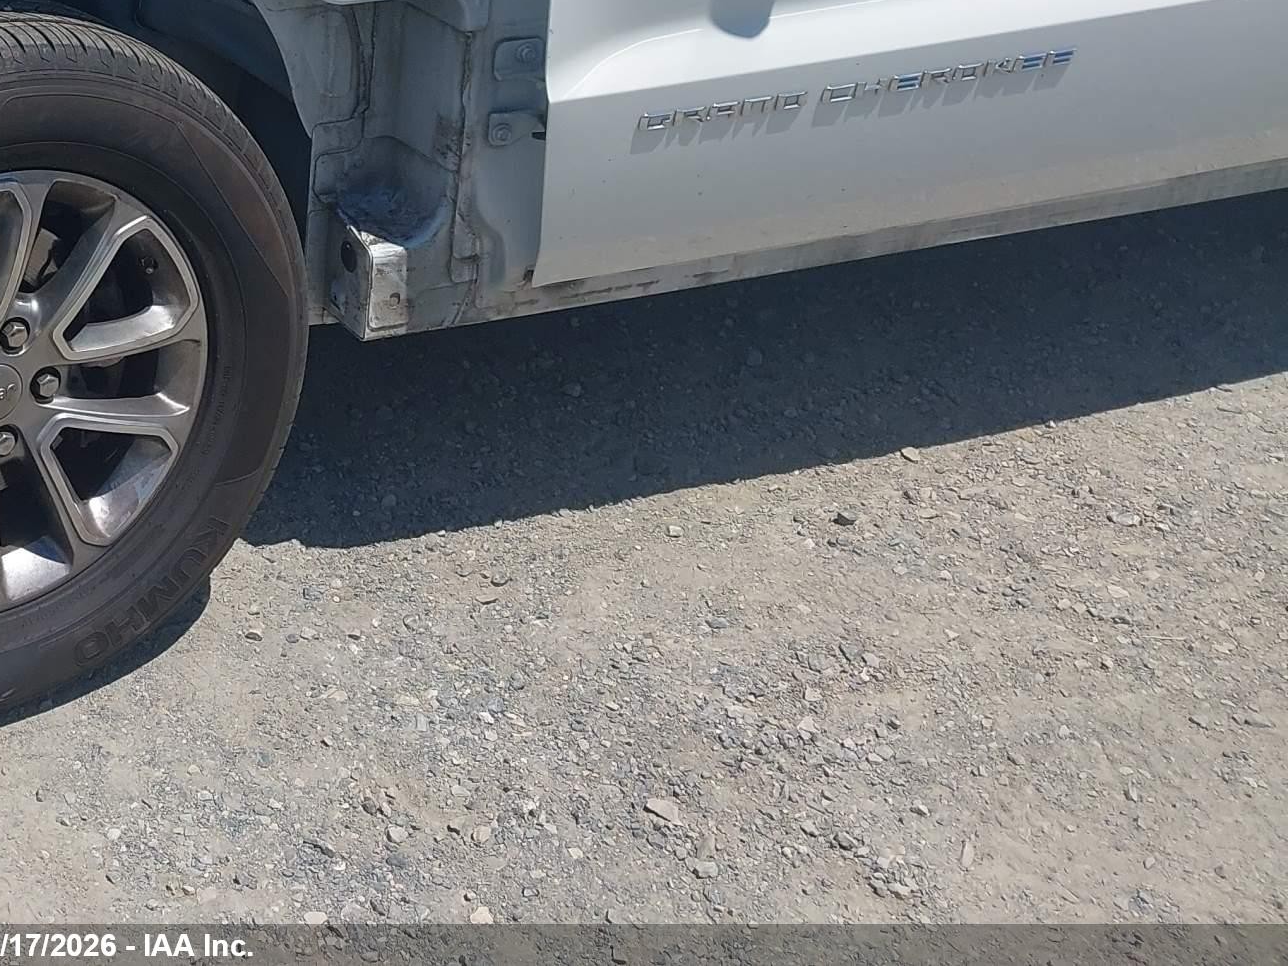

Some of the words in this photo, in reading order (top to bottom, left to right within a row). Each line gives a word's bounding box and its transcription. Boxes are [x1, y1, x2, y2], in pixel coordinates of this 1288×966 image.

[637, 91, 807, 131] GRAND
[821, 48, 1077, 104] CHEROKEE
[74, 516, 231, 667] KUMHO
